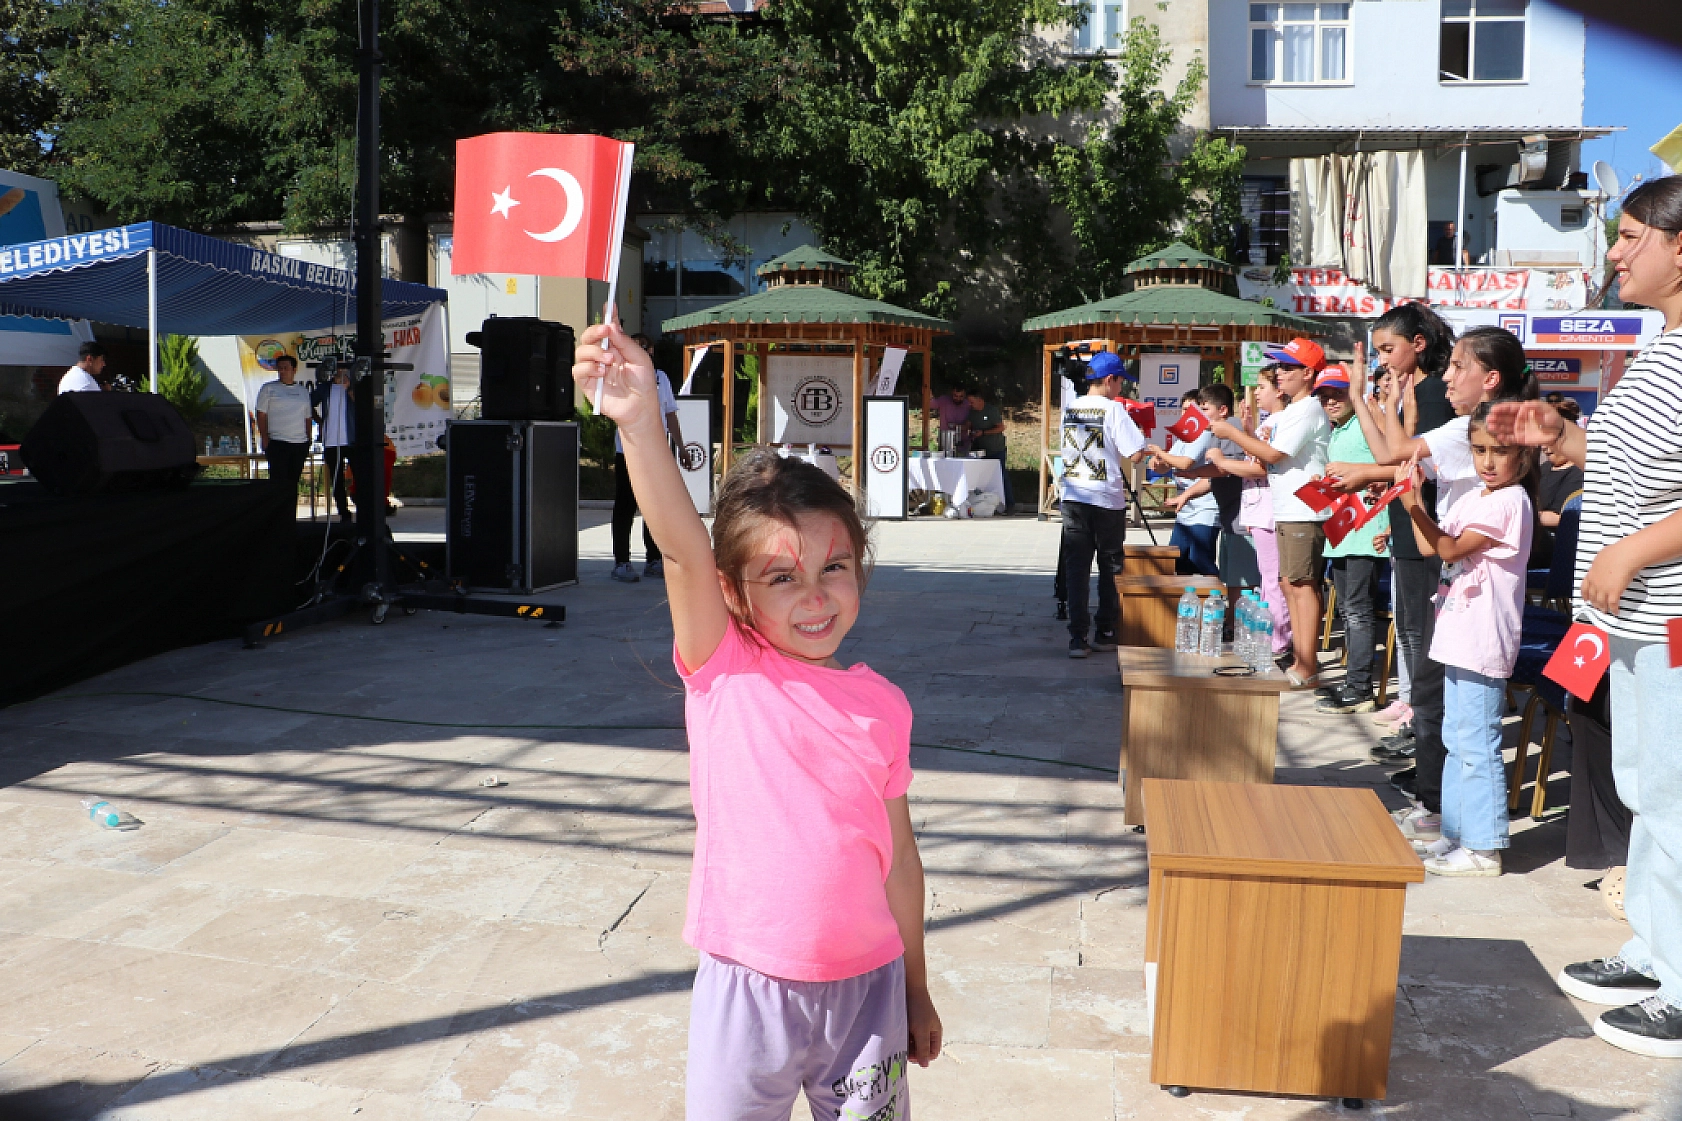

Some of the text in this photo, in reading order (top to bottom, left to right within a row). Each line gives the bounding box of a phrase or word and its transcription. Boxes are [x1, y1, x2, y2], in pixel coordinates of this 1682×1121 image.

[1292, 269, 1362, 286] TERA
[1292, 295, 1376, 314] TERAS
[1560, 319, 1616, 333] SEZA
[1525, 359, 1569, 372] SEZA
[1536, 372, 1570, 380] MENTO
[1143, 396, 1182, 408] SEZ
